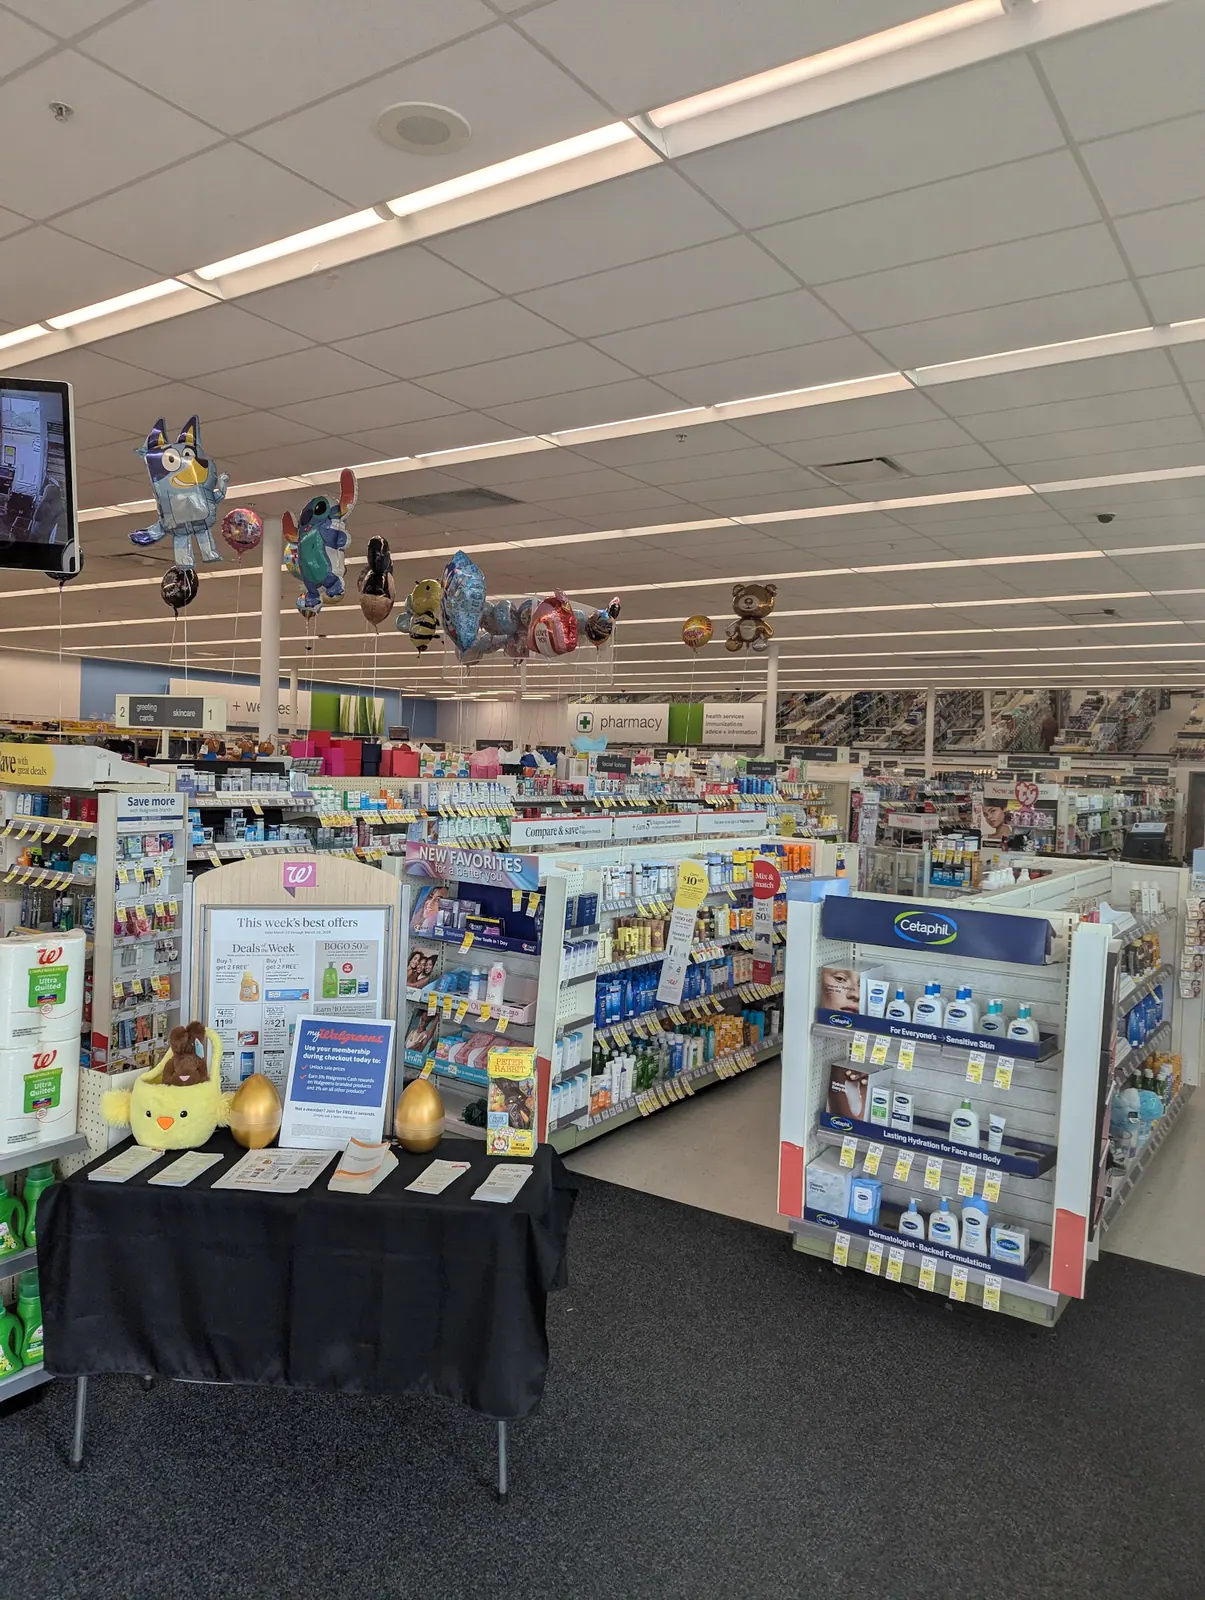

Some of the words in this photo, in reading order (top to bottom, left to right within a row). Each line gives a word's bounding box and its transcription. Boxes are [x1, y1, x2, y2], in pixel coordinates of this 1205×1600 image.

[120, 706, 126, 718] 2
[136, 703, 158, 713] greeting
[172, 708, 196, 718] skincare
[208, 709, 213, 720] 1
[138, 713, 155, 722] cards
[600, 714, 663, 731] pharmacy
[0, 755, 16, 773] ave
[30, 765, 48, 776] deals
[127, 796, 150, 807] Save
[151, 797, 176, 806] more
[525, 826, 557, 840] Compare
[558, 826, 564, 836] &
[564, 827, 580, 836] save
[418, 846, 447, 864] NEW
[450, 851, 523, 874] FAVORITES
[434, 863, 447, 873] for
[448, 867, 455, 875] a
[457, 866, 485, 879] better
[485, 871, 503, 883] you
[755, 872, 768, 881] Mix
[682, 875, 698, 887] $10
[754, 880, 774, 889] match
[236, 917, 262, 928] This
[264, 916, 301, 928] week's
[302, 916, 326, 928] best
[327, 916, 358, 928] offers
[900, 917, 949, 938] Cetaphil
[232, 943, 261, 953] Deals
[268, 942, 296, 953] Week
[324, 942, 351, 951] BOGO
[266, 957, 278, 965] Buy
[39, 977, 58, 985] Ultra
[34, 982, 62, 993] Quilted
[831, 1017, 850, 1025] Cetaphil
[890, 1026, 901, 1035] For
[901, 1027, 938, 1041] Everyone's
[945, 1035, 979, 1048] Sensitive
[978, 1040, 996, 1051] Skin
[304, 1044, 316, 1052] Use
[316, 1046, 331, 1054] your
[331, 1047, 371, 1056] membership
[302, 1053, 324, 1061] during
[323, 1054, 353, 1063] checkout
[353, 1056, 371, 1065] today
[496, 1058, 524, 1067] PETER
[494, 1065, 526, 1074] RABBIT
[34, 1081, 52, 1090] Ultra
[29, 1087, 57, 1098] Quilted
[832, 1119, 850, 1129] Cetaphil
[883, 1129, 908, 1144] Lasting
[907, 1135, 940, 1150] Hydration
[940, 1143, 951, 1152] for
[951, 1146, 968, 1158] Face
[968, 1150, 982, 1160] and
[982, 1153, 1002, 1167] Body
[945, 1251, 992, 1270] Formulations
